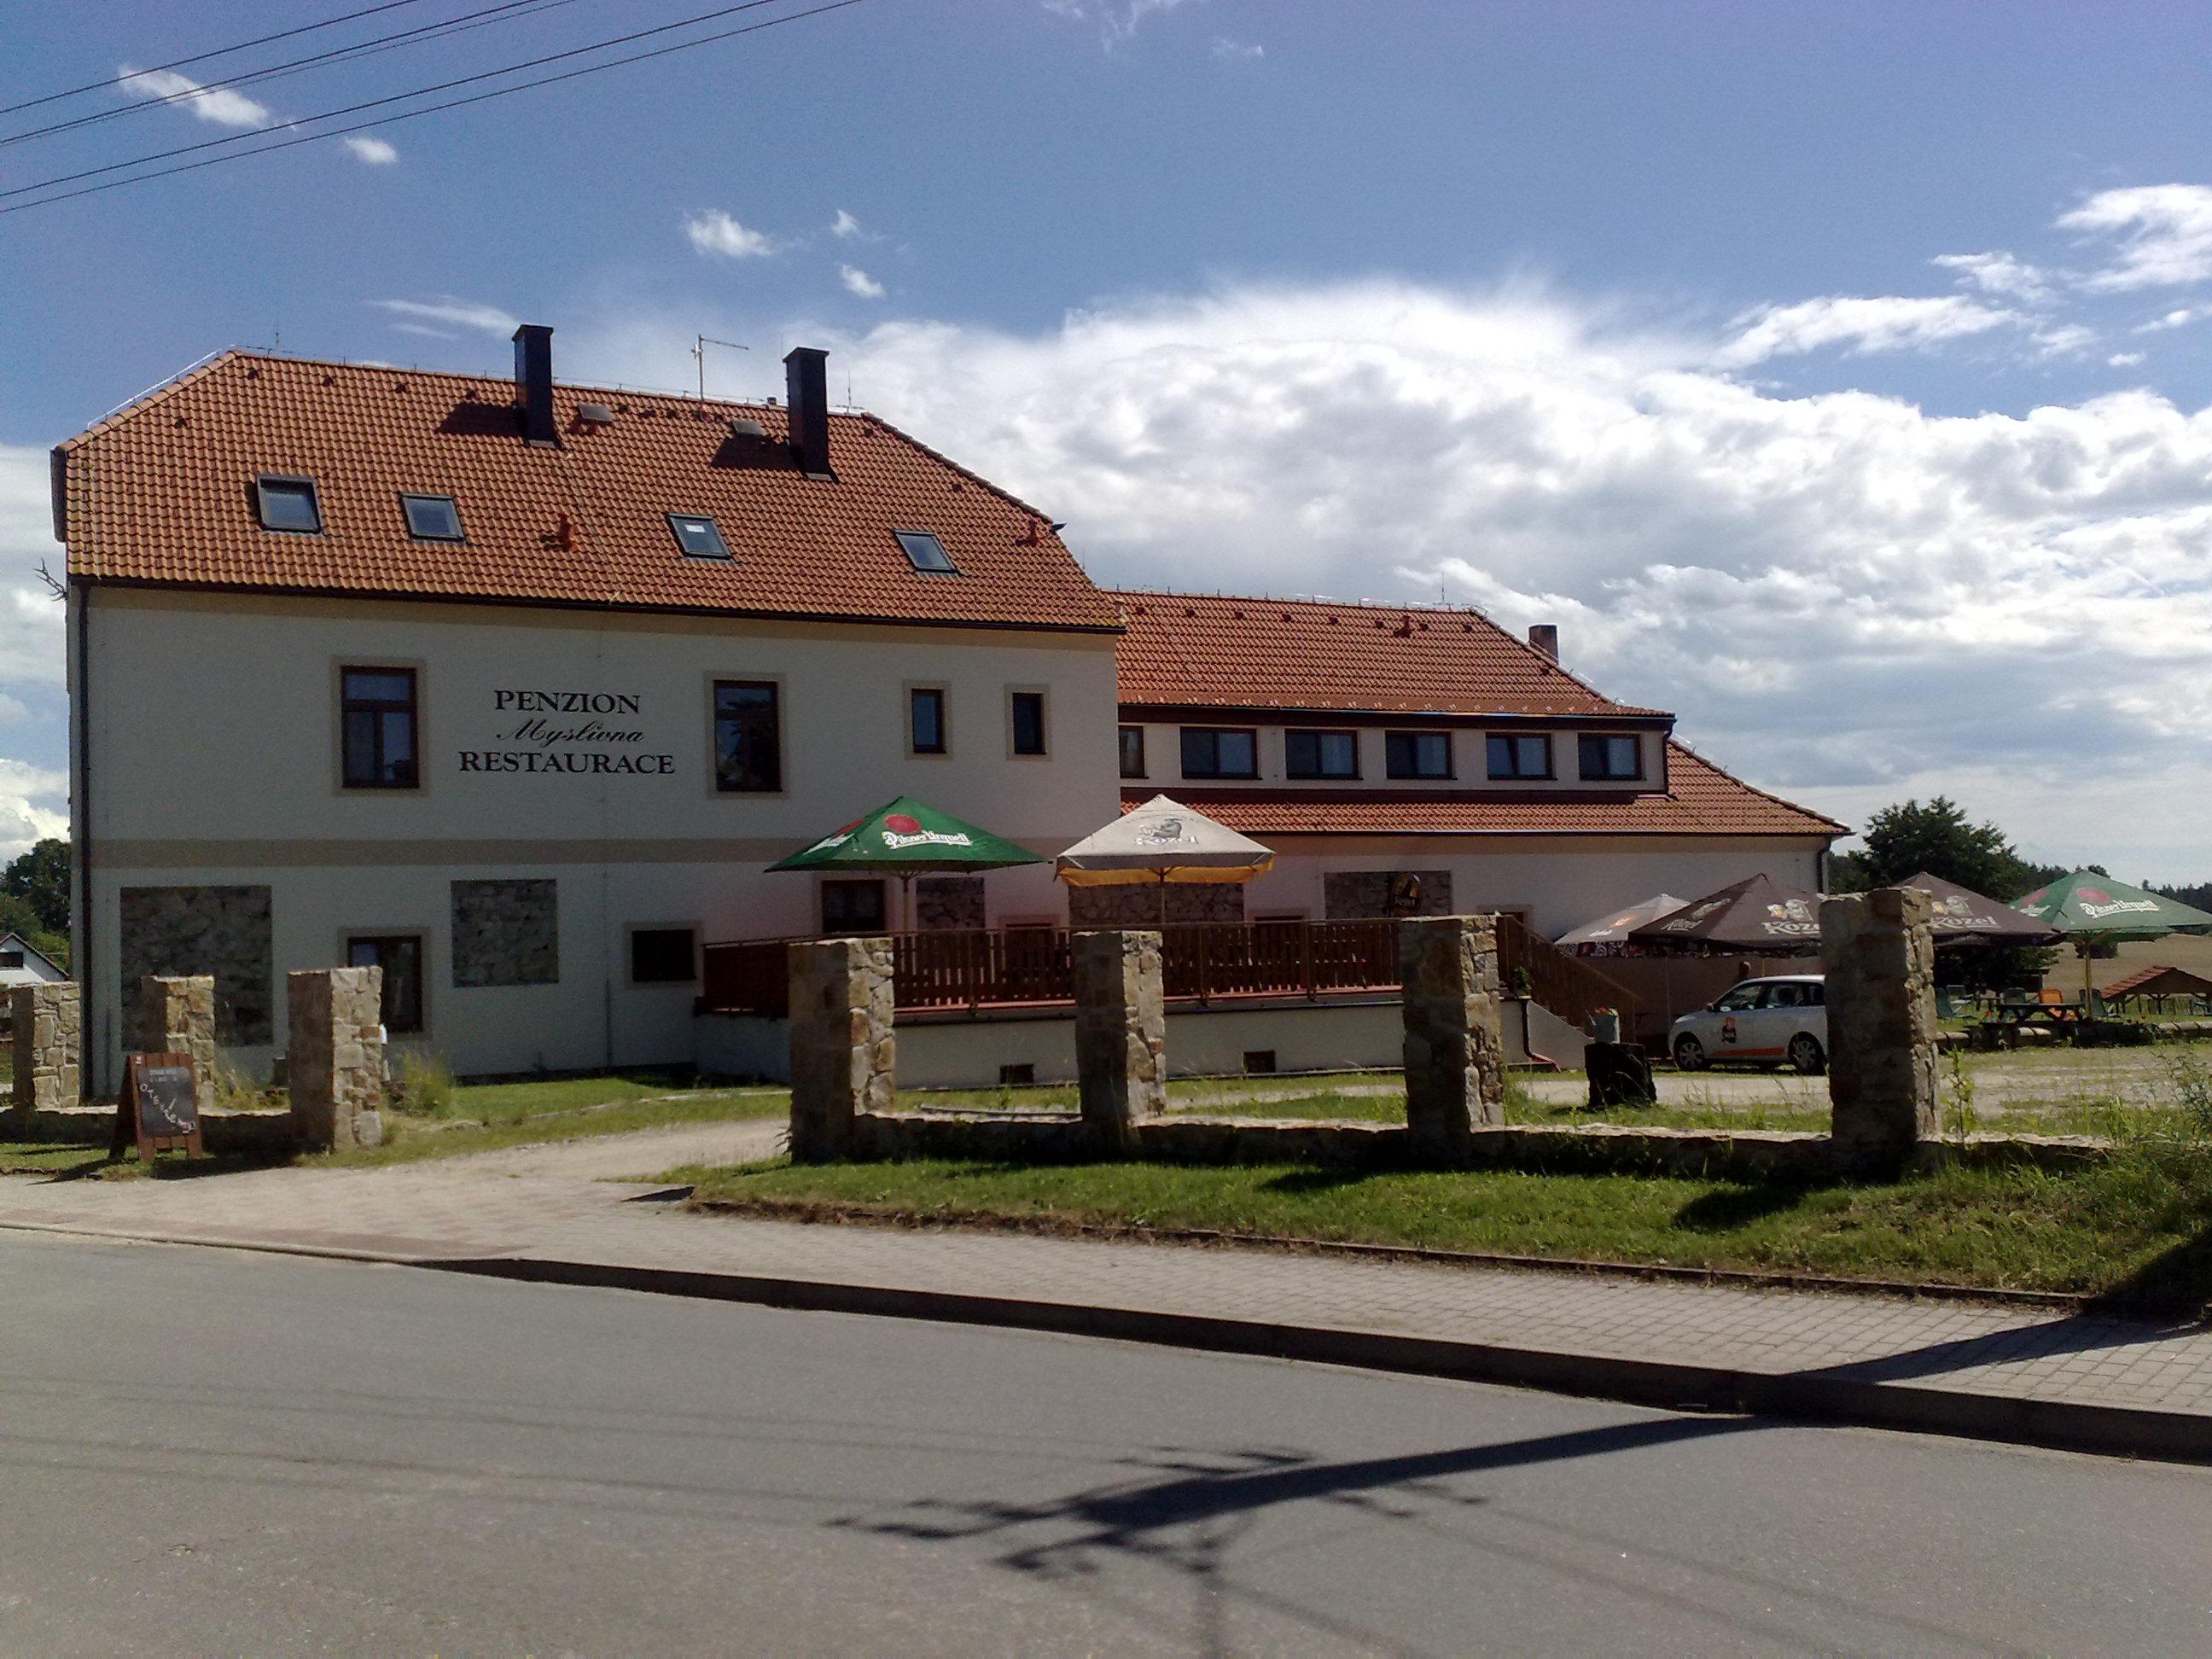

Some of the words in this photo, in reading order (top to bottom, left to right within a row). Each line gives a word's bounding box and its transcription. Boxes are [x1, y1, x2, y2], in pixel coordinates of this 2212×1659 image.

[494, 690, 640, 713] PENZION
[496, 719, 643, 748] Myslivna
[458, 751, 675, 774] RESTAURACE
[1761, 922, 1820, 935] Koze
